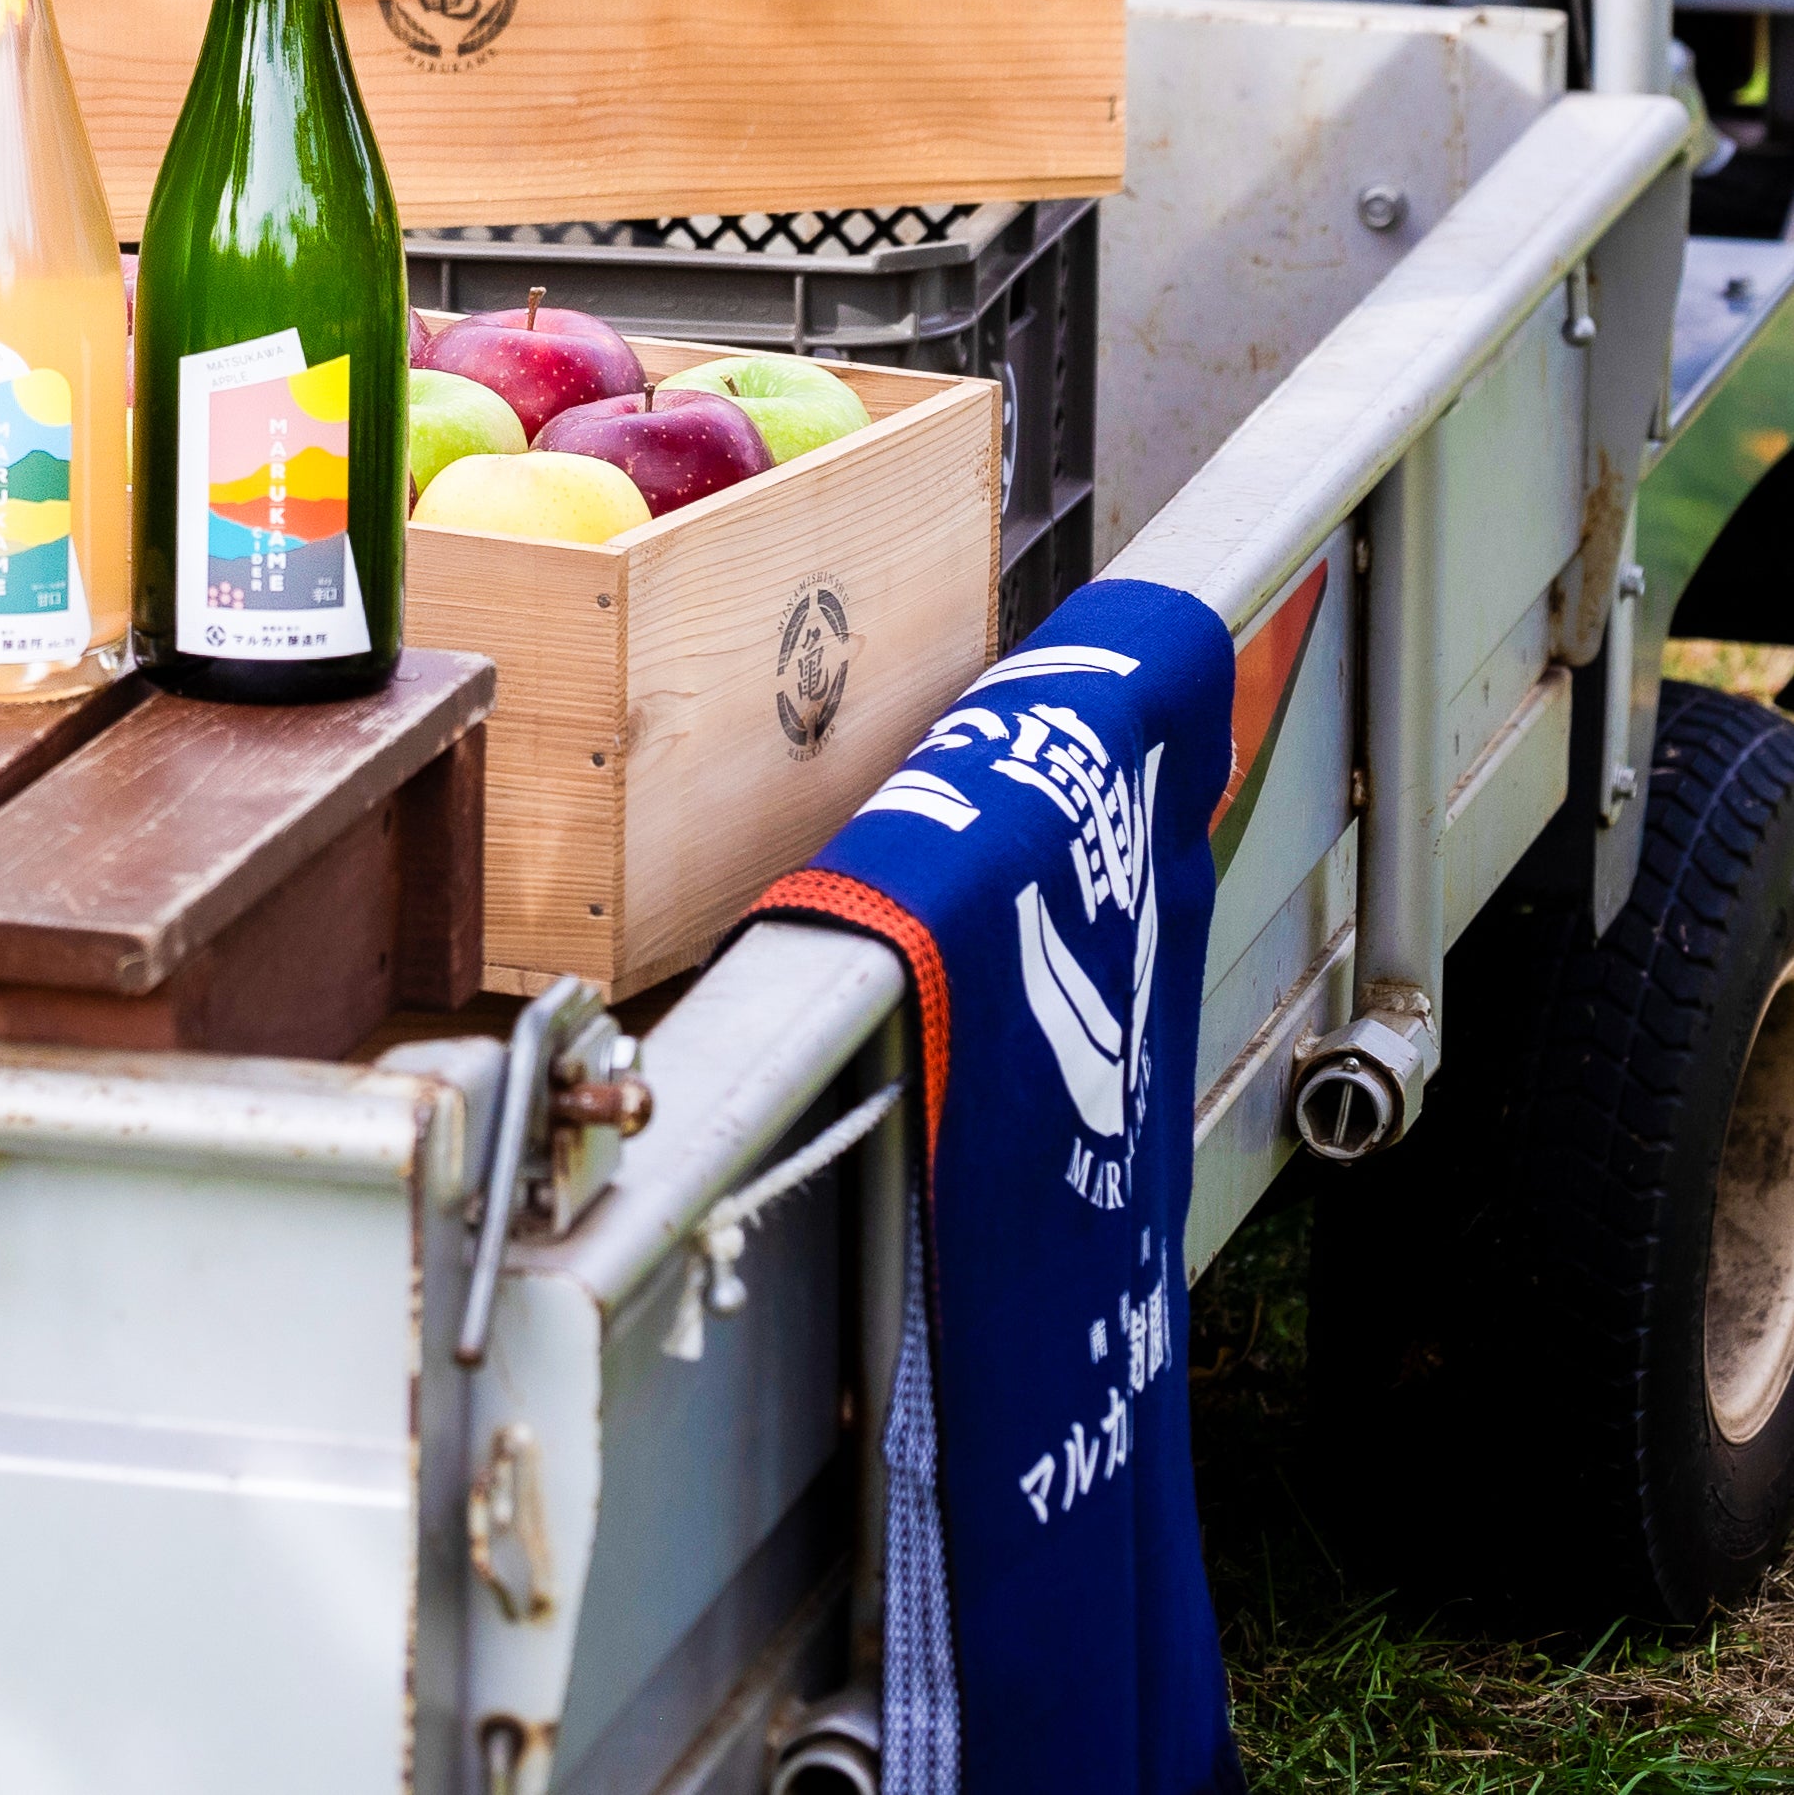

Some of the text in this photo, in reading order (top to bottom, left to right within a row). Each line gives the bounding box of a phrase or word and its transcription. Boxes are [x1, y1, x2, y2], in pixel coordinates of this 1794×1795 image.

[206, 345, 285, 373] MATSUKAWA
[211, 373, 249, 388] APPLE
[267, 418, 289, 593] MARUKAME
[250, 526, 263, 593] CIDER
